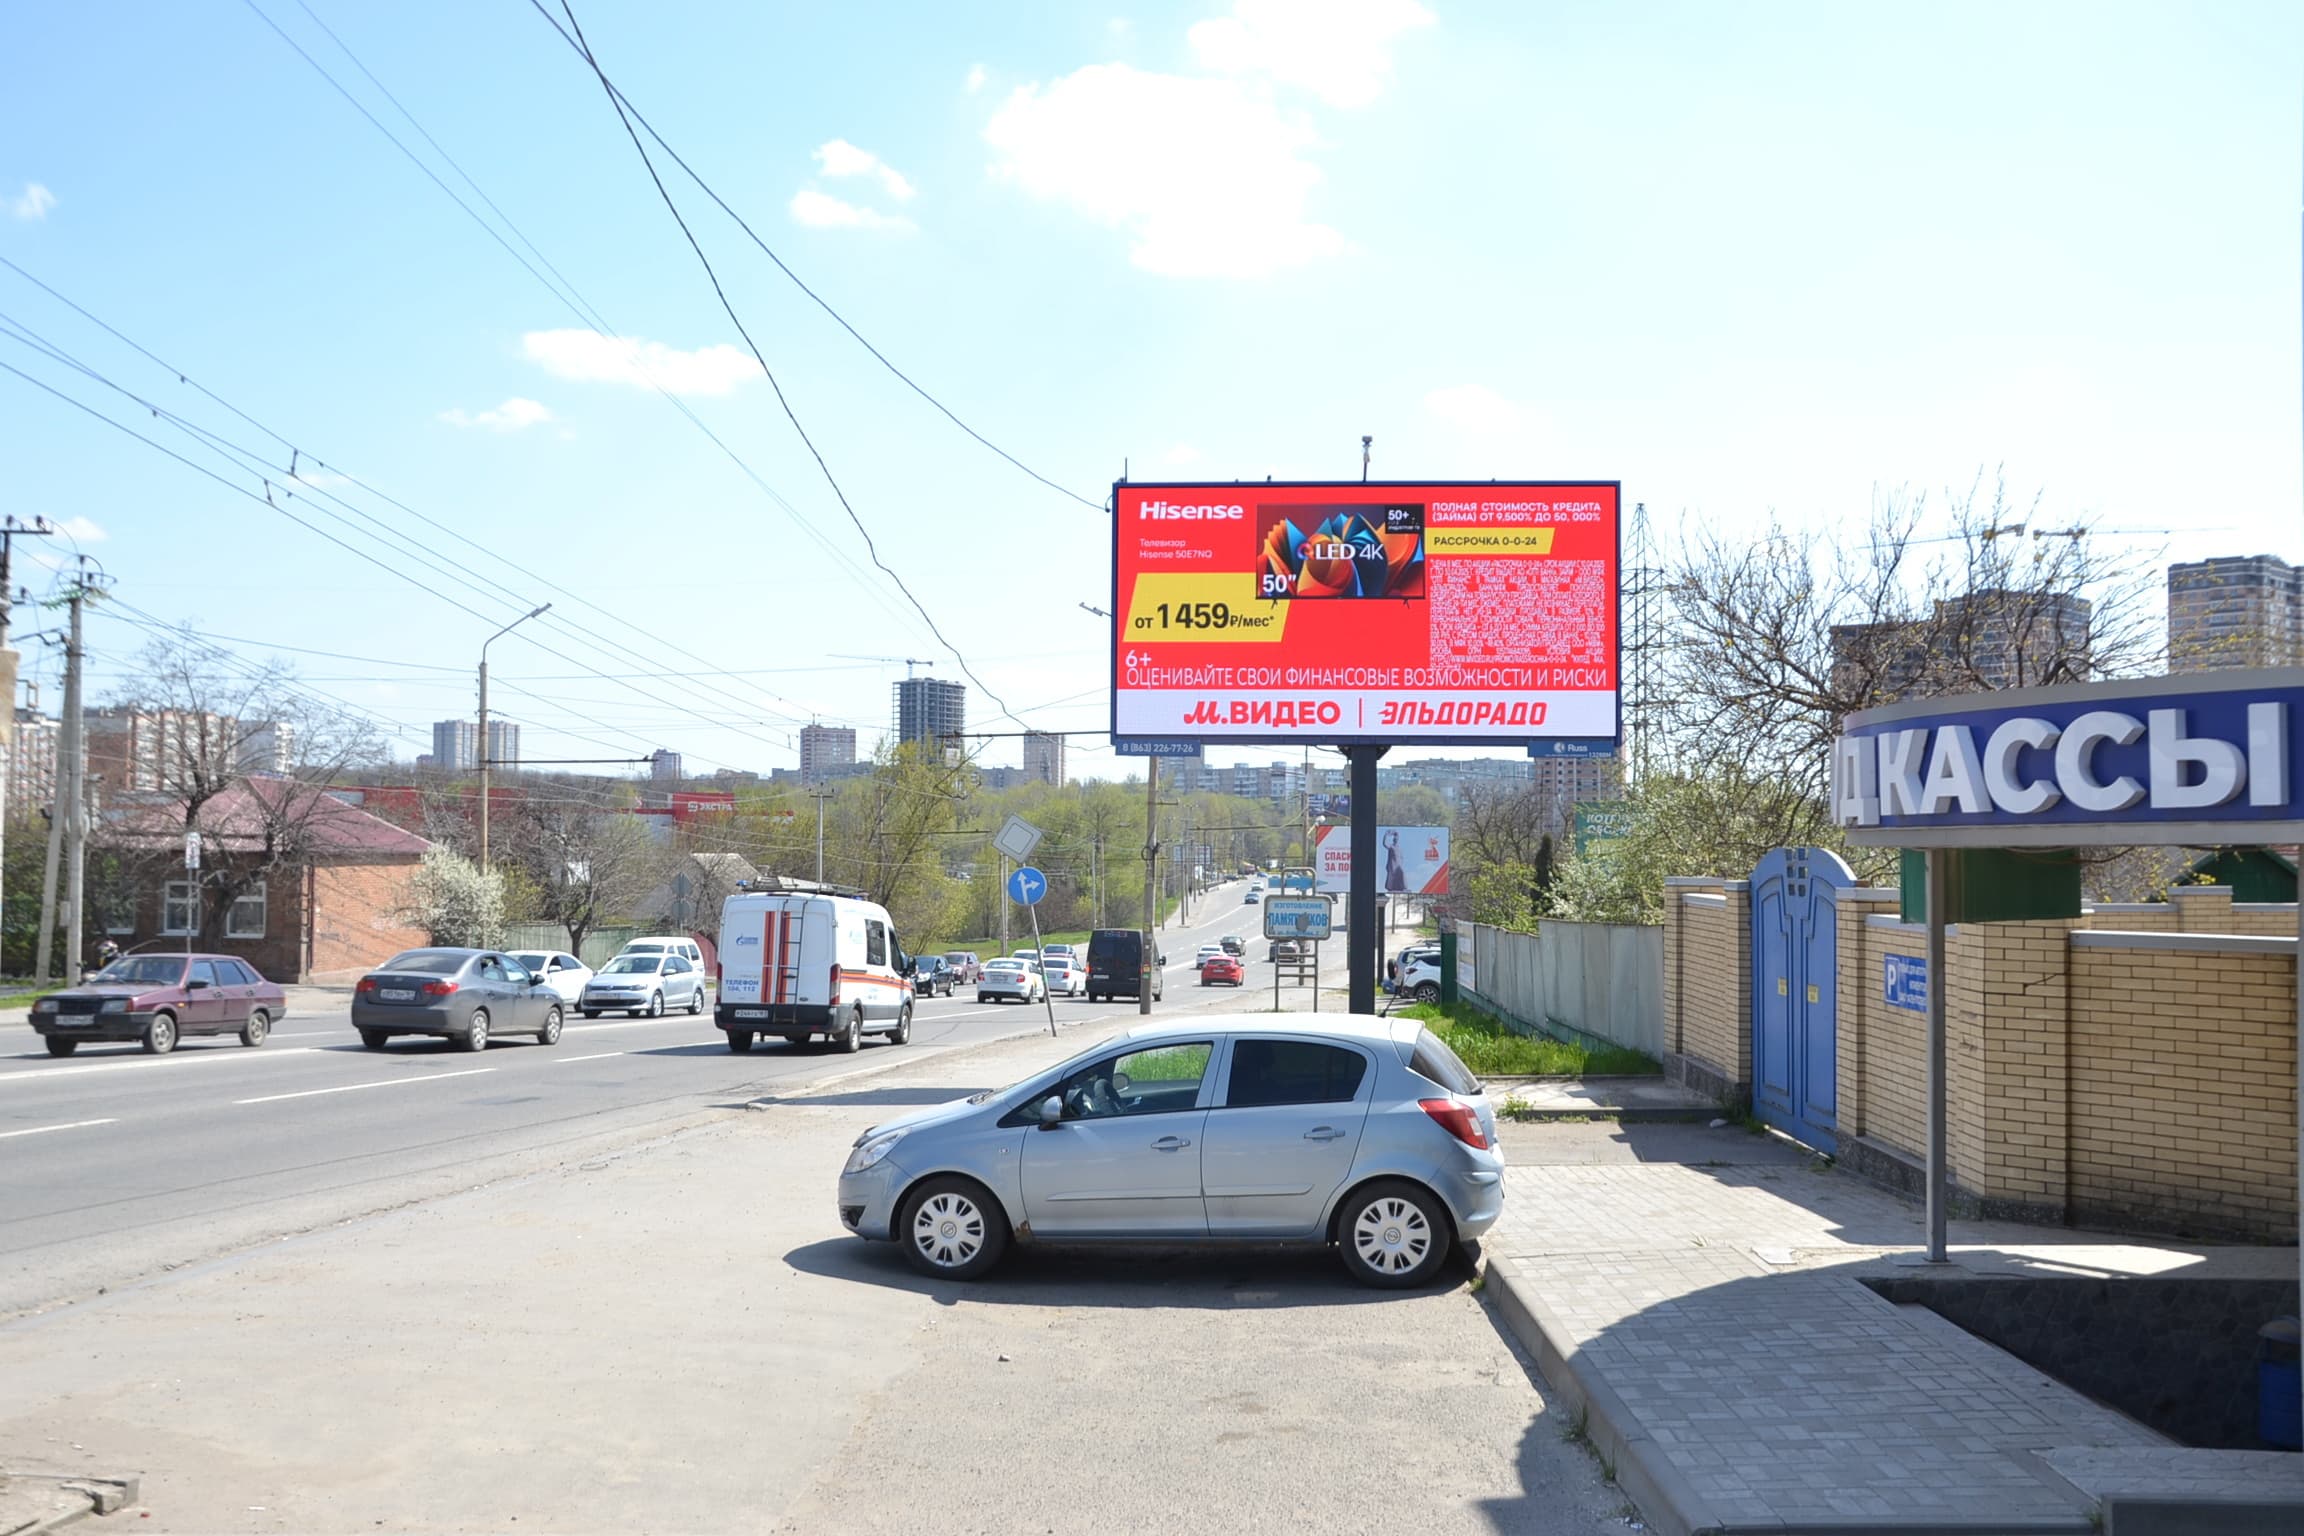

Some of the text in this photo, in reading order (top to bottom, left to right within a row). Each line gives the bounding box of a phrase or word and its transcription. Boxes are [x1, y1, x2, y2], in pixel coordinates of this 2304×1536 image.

[1140, 501, 1243, 520] Hisense
[1432, 502, 1601, 513] ПОЛНАЯ СТОИМОСТЬ КРЕДИТА
[1387, 509, 1410, 520] 50+
[1480, 512, 1494, 521] ОТ
[1534, 512, 1552, 522] ДО
[1139, 539, 1187, 549] Телевизор
[1434, 537, 1537, 546] РАССРОЧКА 0-0-24
[1139, 550, 1174, 559] Hisense
[1359, 543, 1384, 560] 4K
[1135, 617, 1154, 628] от
[1125, 650, 1152, 668] 6+
[1126, 664, 1607, 688] ОЦЕНИВАЙТЕ СВОИ ФИНАНСОВЫЕ ВОЗМОЖНОСТИ И РИСКИ
[1378, 701, 1548, 726] ЭЛЬДОРАДО
[1122, 743, 1193, 753] 8 (863) 226-77-26
[1567, 743, 1588, 752] Russ
[1324, 863, 1351, 873] ЗА ПО
[1268, 912, 1329, 927] ПАМЯТКОВ
